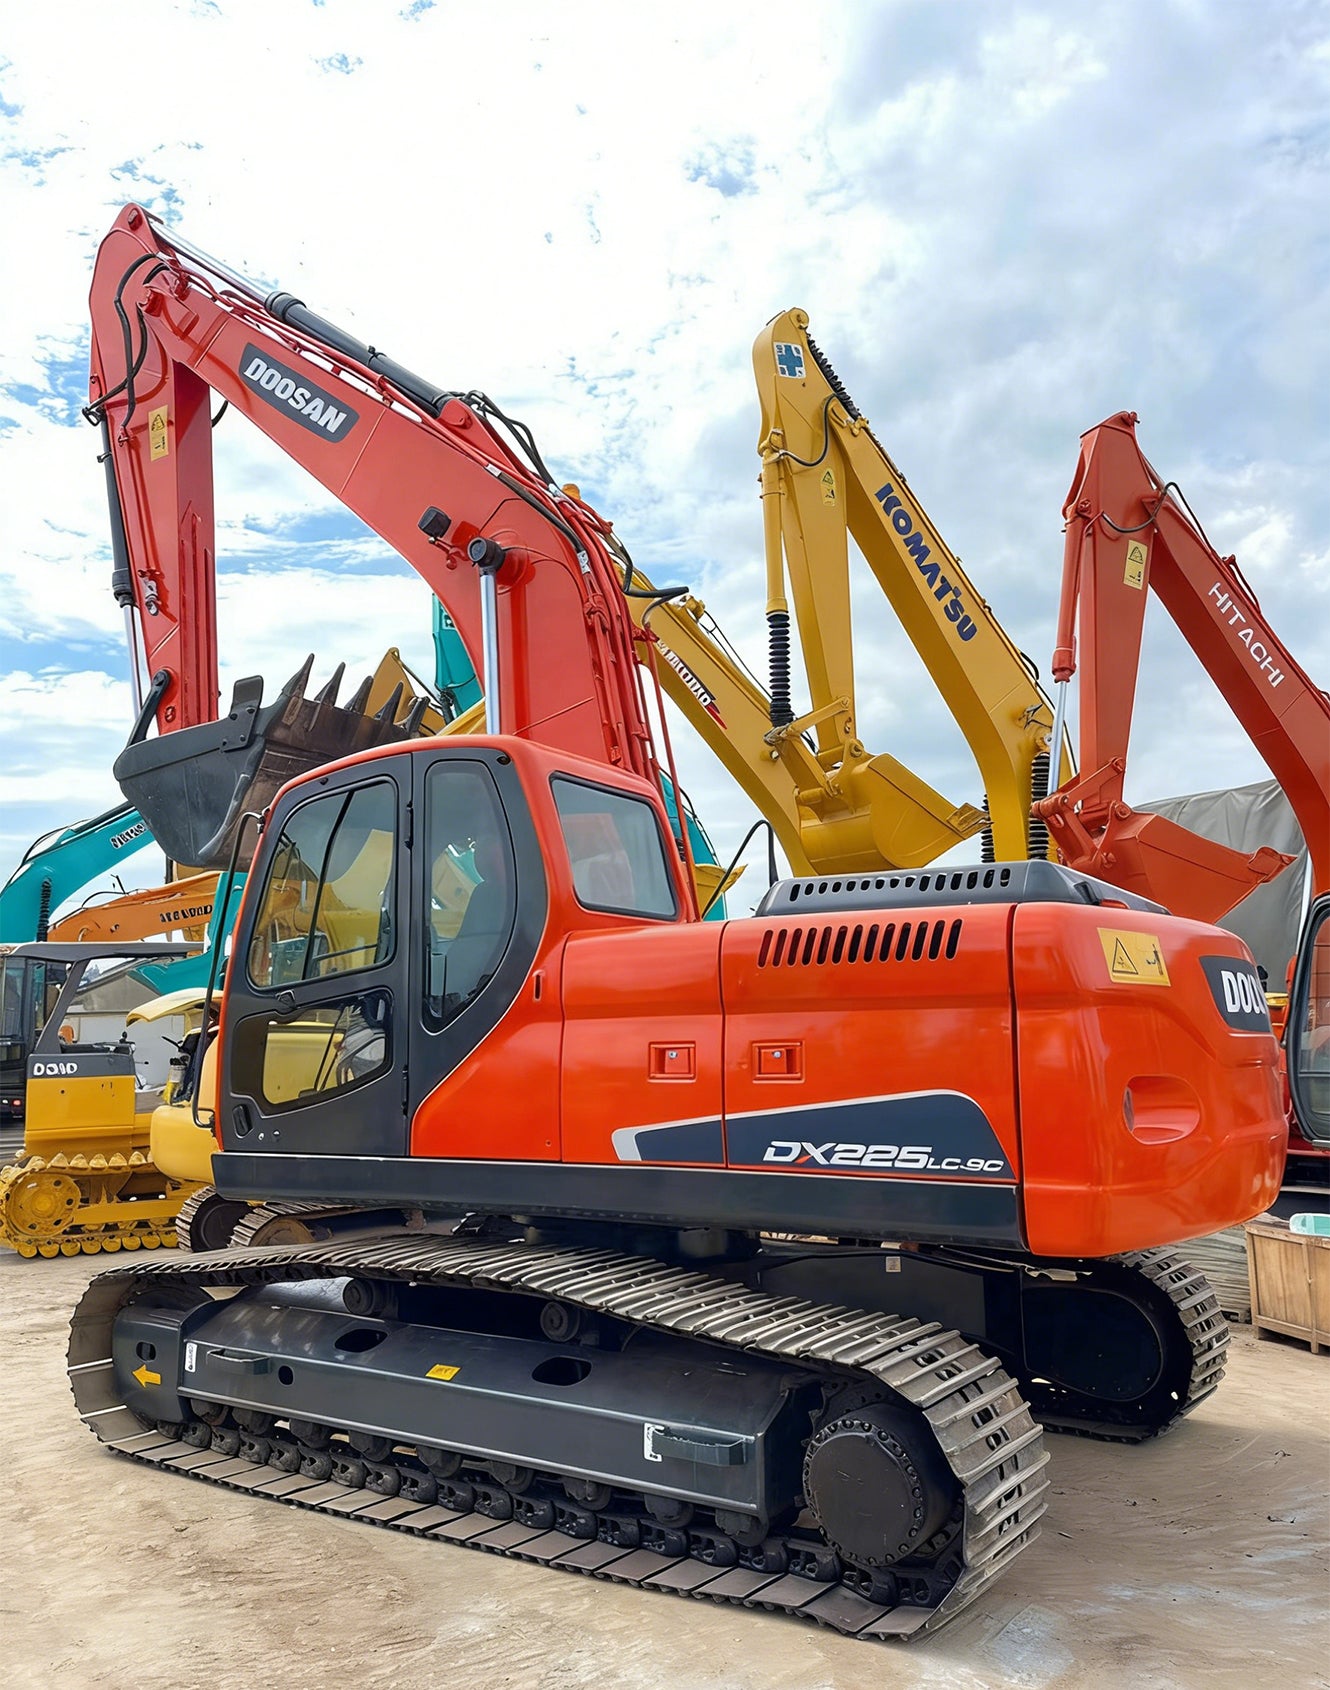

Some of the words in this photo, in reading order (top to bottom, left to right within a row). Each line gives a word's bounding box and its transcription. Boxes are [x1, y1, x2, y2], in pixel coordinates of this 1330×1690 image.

[243, 357, 347, 434] DOOSAN
[874, 482, 978, 642] KOMATSU
[1208, 582, 1285, 688] HITACHI
